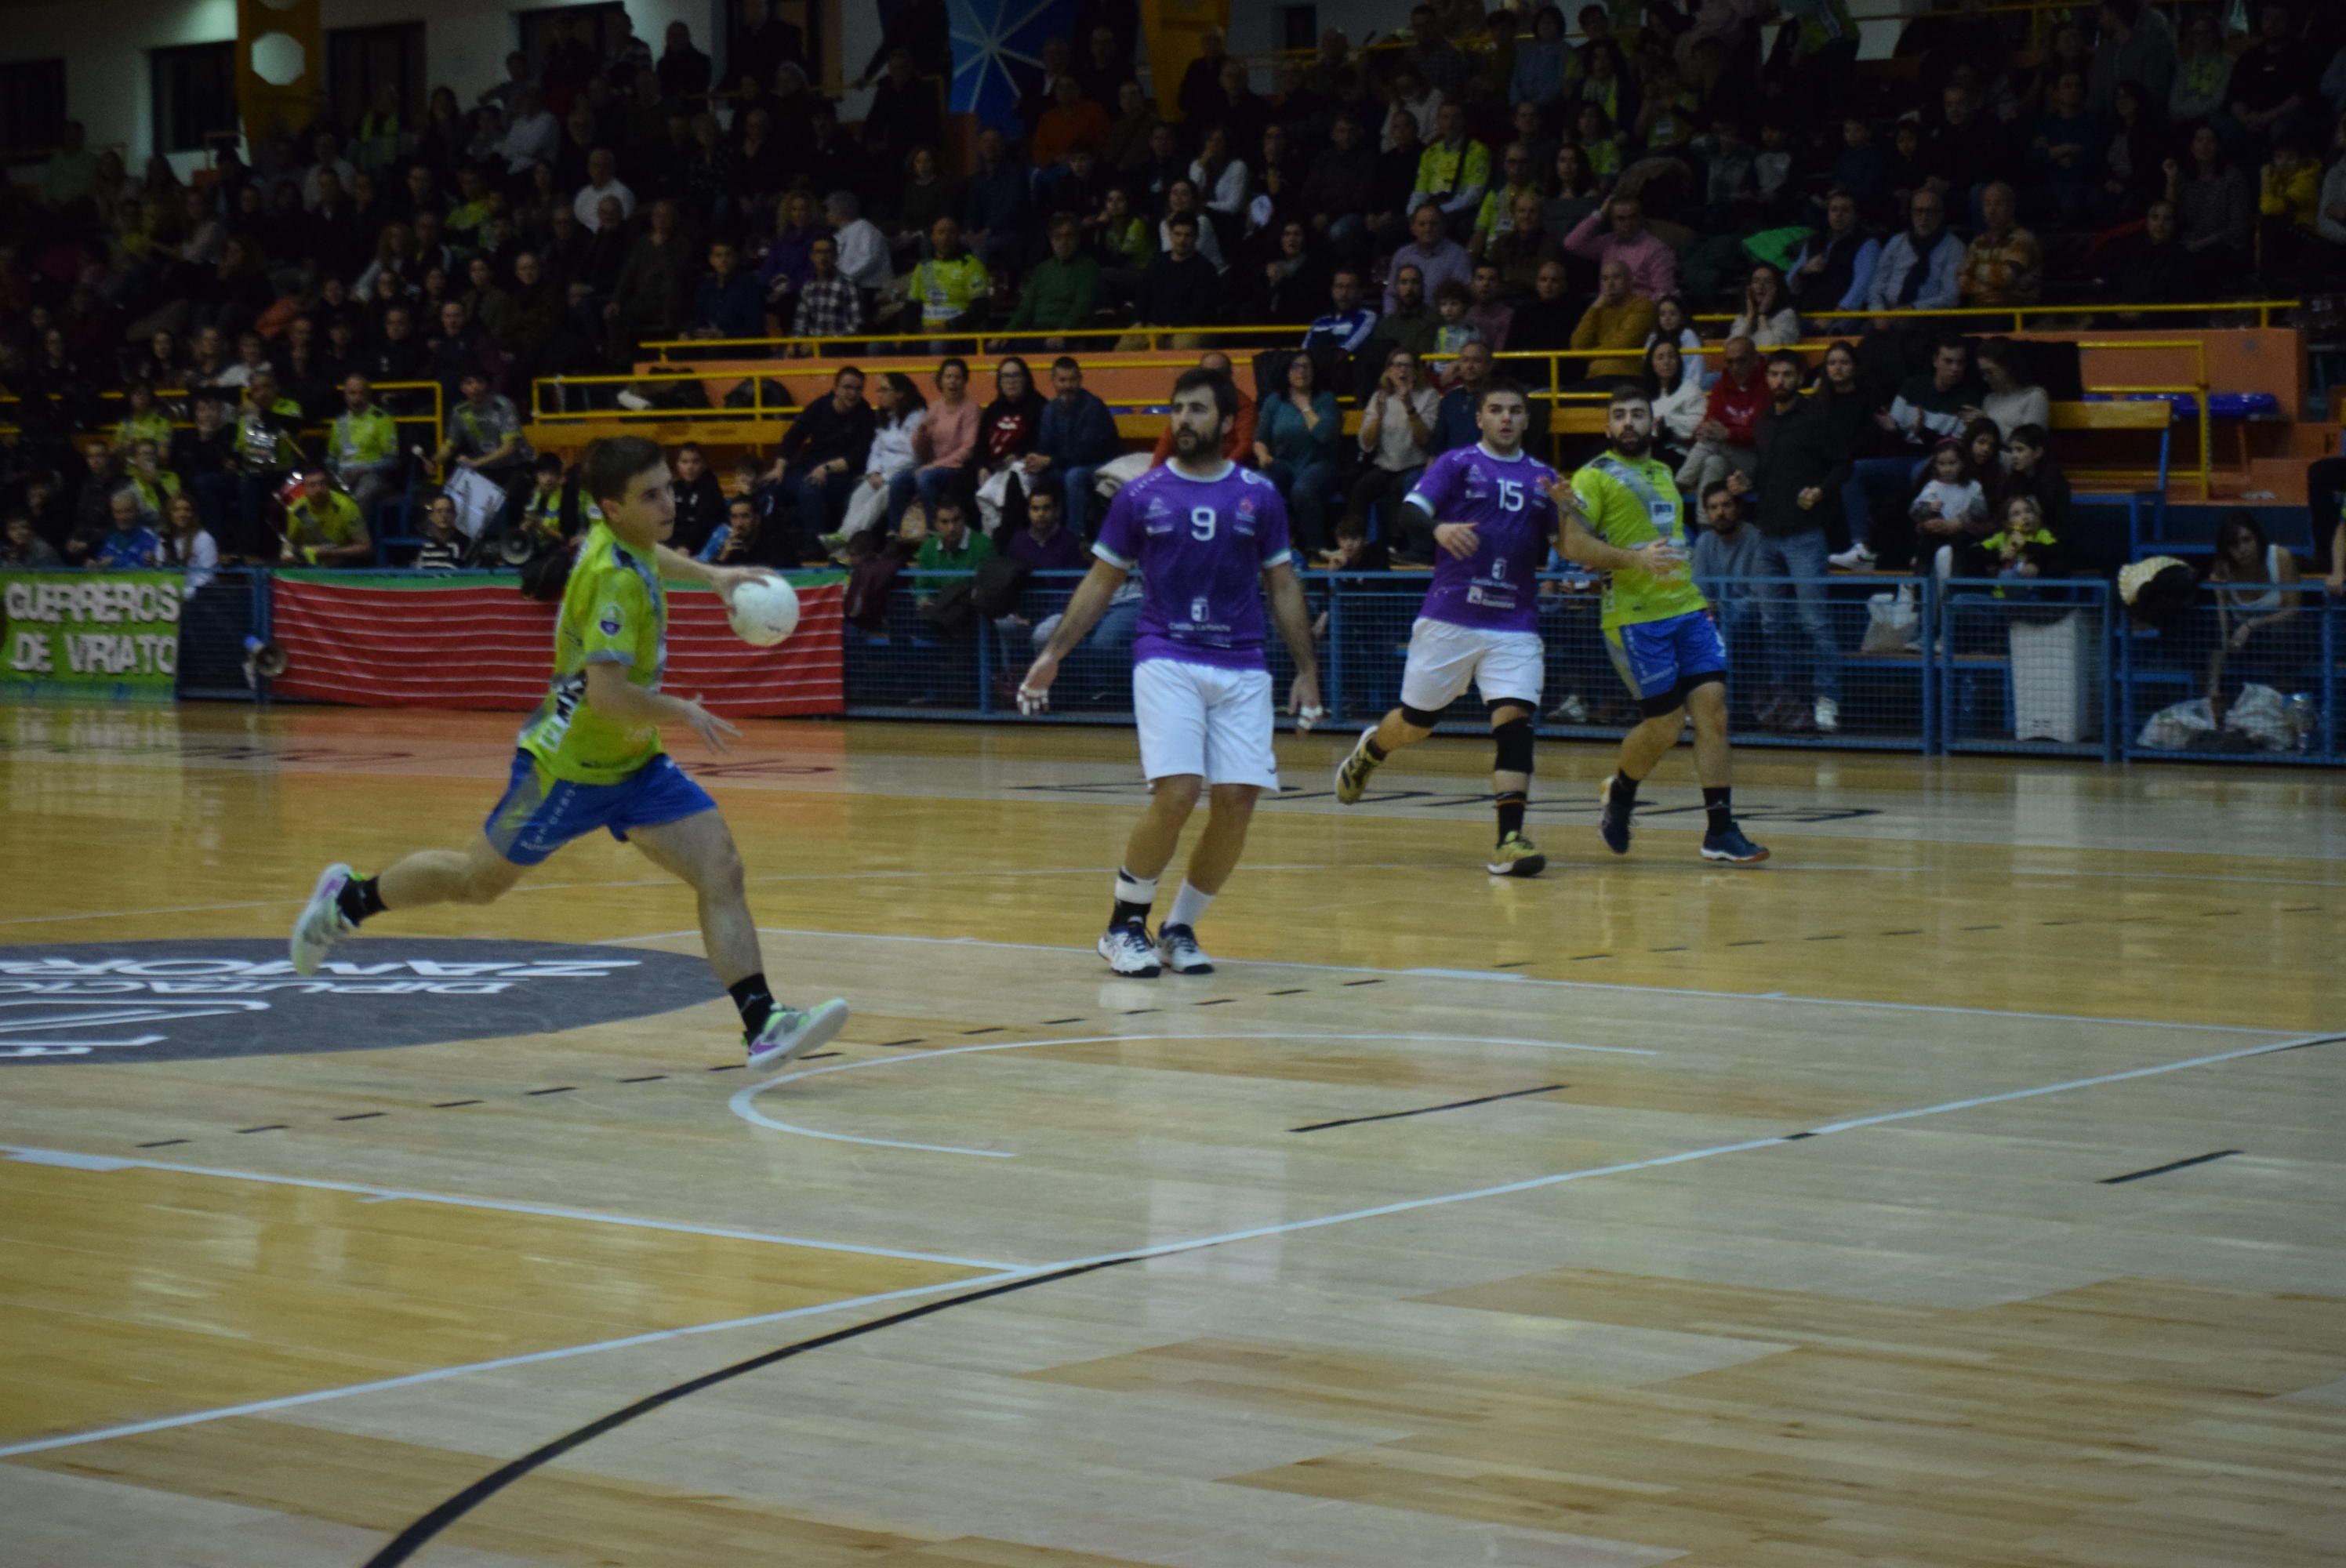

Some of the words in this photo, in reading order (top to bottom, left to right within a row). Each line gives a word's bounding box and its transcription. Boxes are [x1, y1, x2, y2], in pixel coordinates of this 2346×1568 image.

[1495, 477, 1525, 513] 15
[1189, 505, 1218, 542] 9
[5, 582, 180, 624] GUERREROS
[10, 631, 53, 673] DE
[64, 632, 177, 675] VIRIATO
